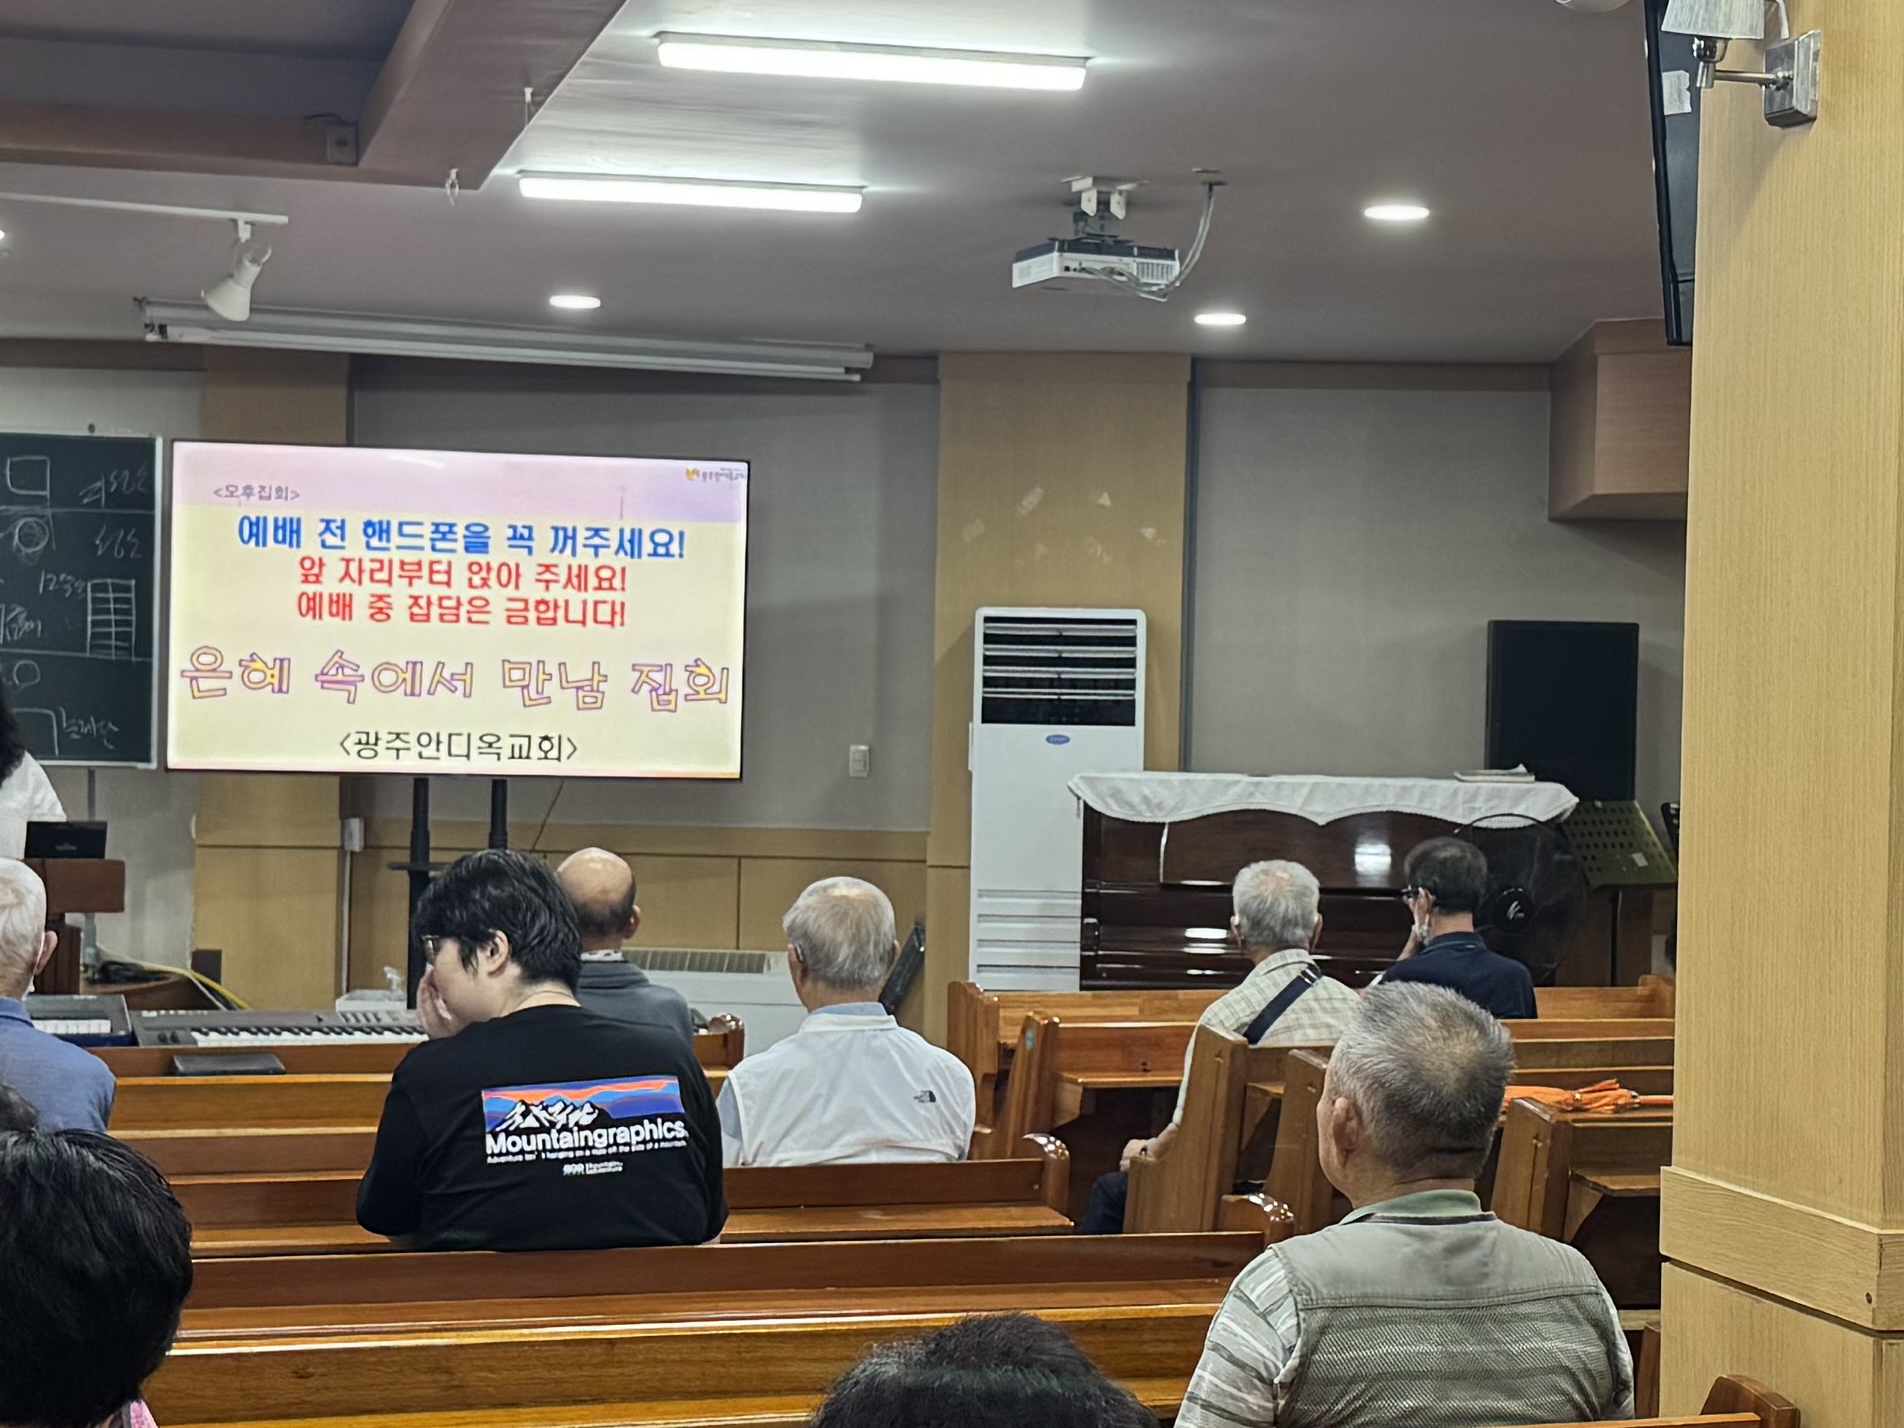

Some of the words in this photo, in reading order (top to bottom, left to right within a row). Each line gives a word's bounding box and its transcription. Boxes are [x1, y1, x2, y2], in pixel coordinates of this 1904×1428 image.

[238, 515, 302, 549] 예배
[318, 518, 346, 550] 전
[362, 519, 491, 555] 핸드폰을
[506, 524, 535, 556] 꼭
[549, 525, 685, 559] 꺼주세요!
[299, 555, 327, 585] 앞
[338, 557, 453, 588] 자리부터
[467, 560, 522, 588] 앉아
[534, 562, 627, 593] 주세요!
[297, 591, 353, 622] 예배
[368, 593, 394, 623] 중
[407, 595, 492, 625] 잡담은
[504, 597, 626, 628] 금합니다!
[180, 645, 291, 700] 은혜
[315, 649, 474, 704] 속에서
[502, 659, 608, 711] 만남
[631, 658, 730, 713] 집회
[339, 730, 578, 763] <광주안디옥교회>
